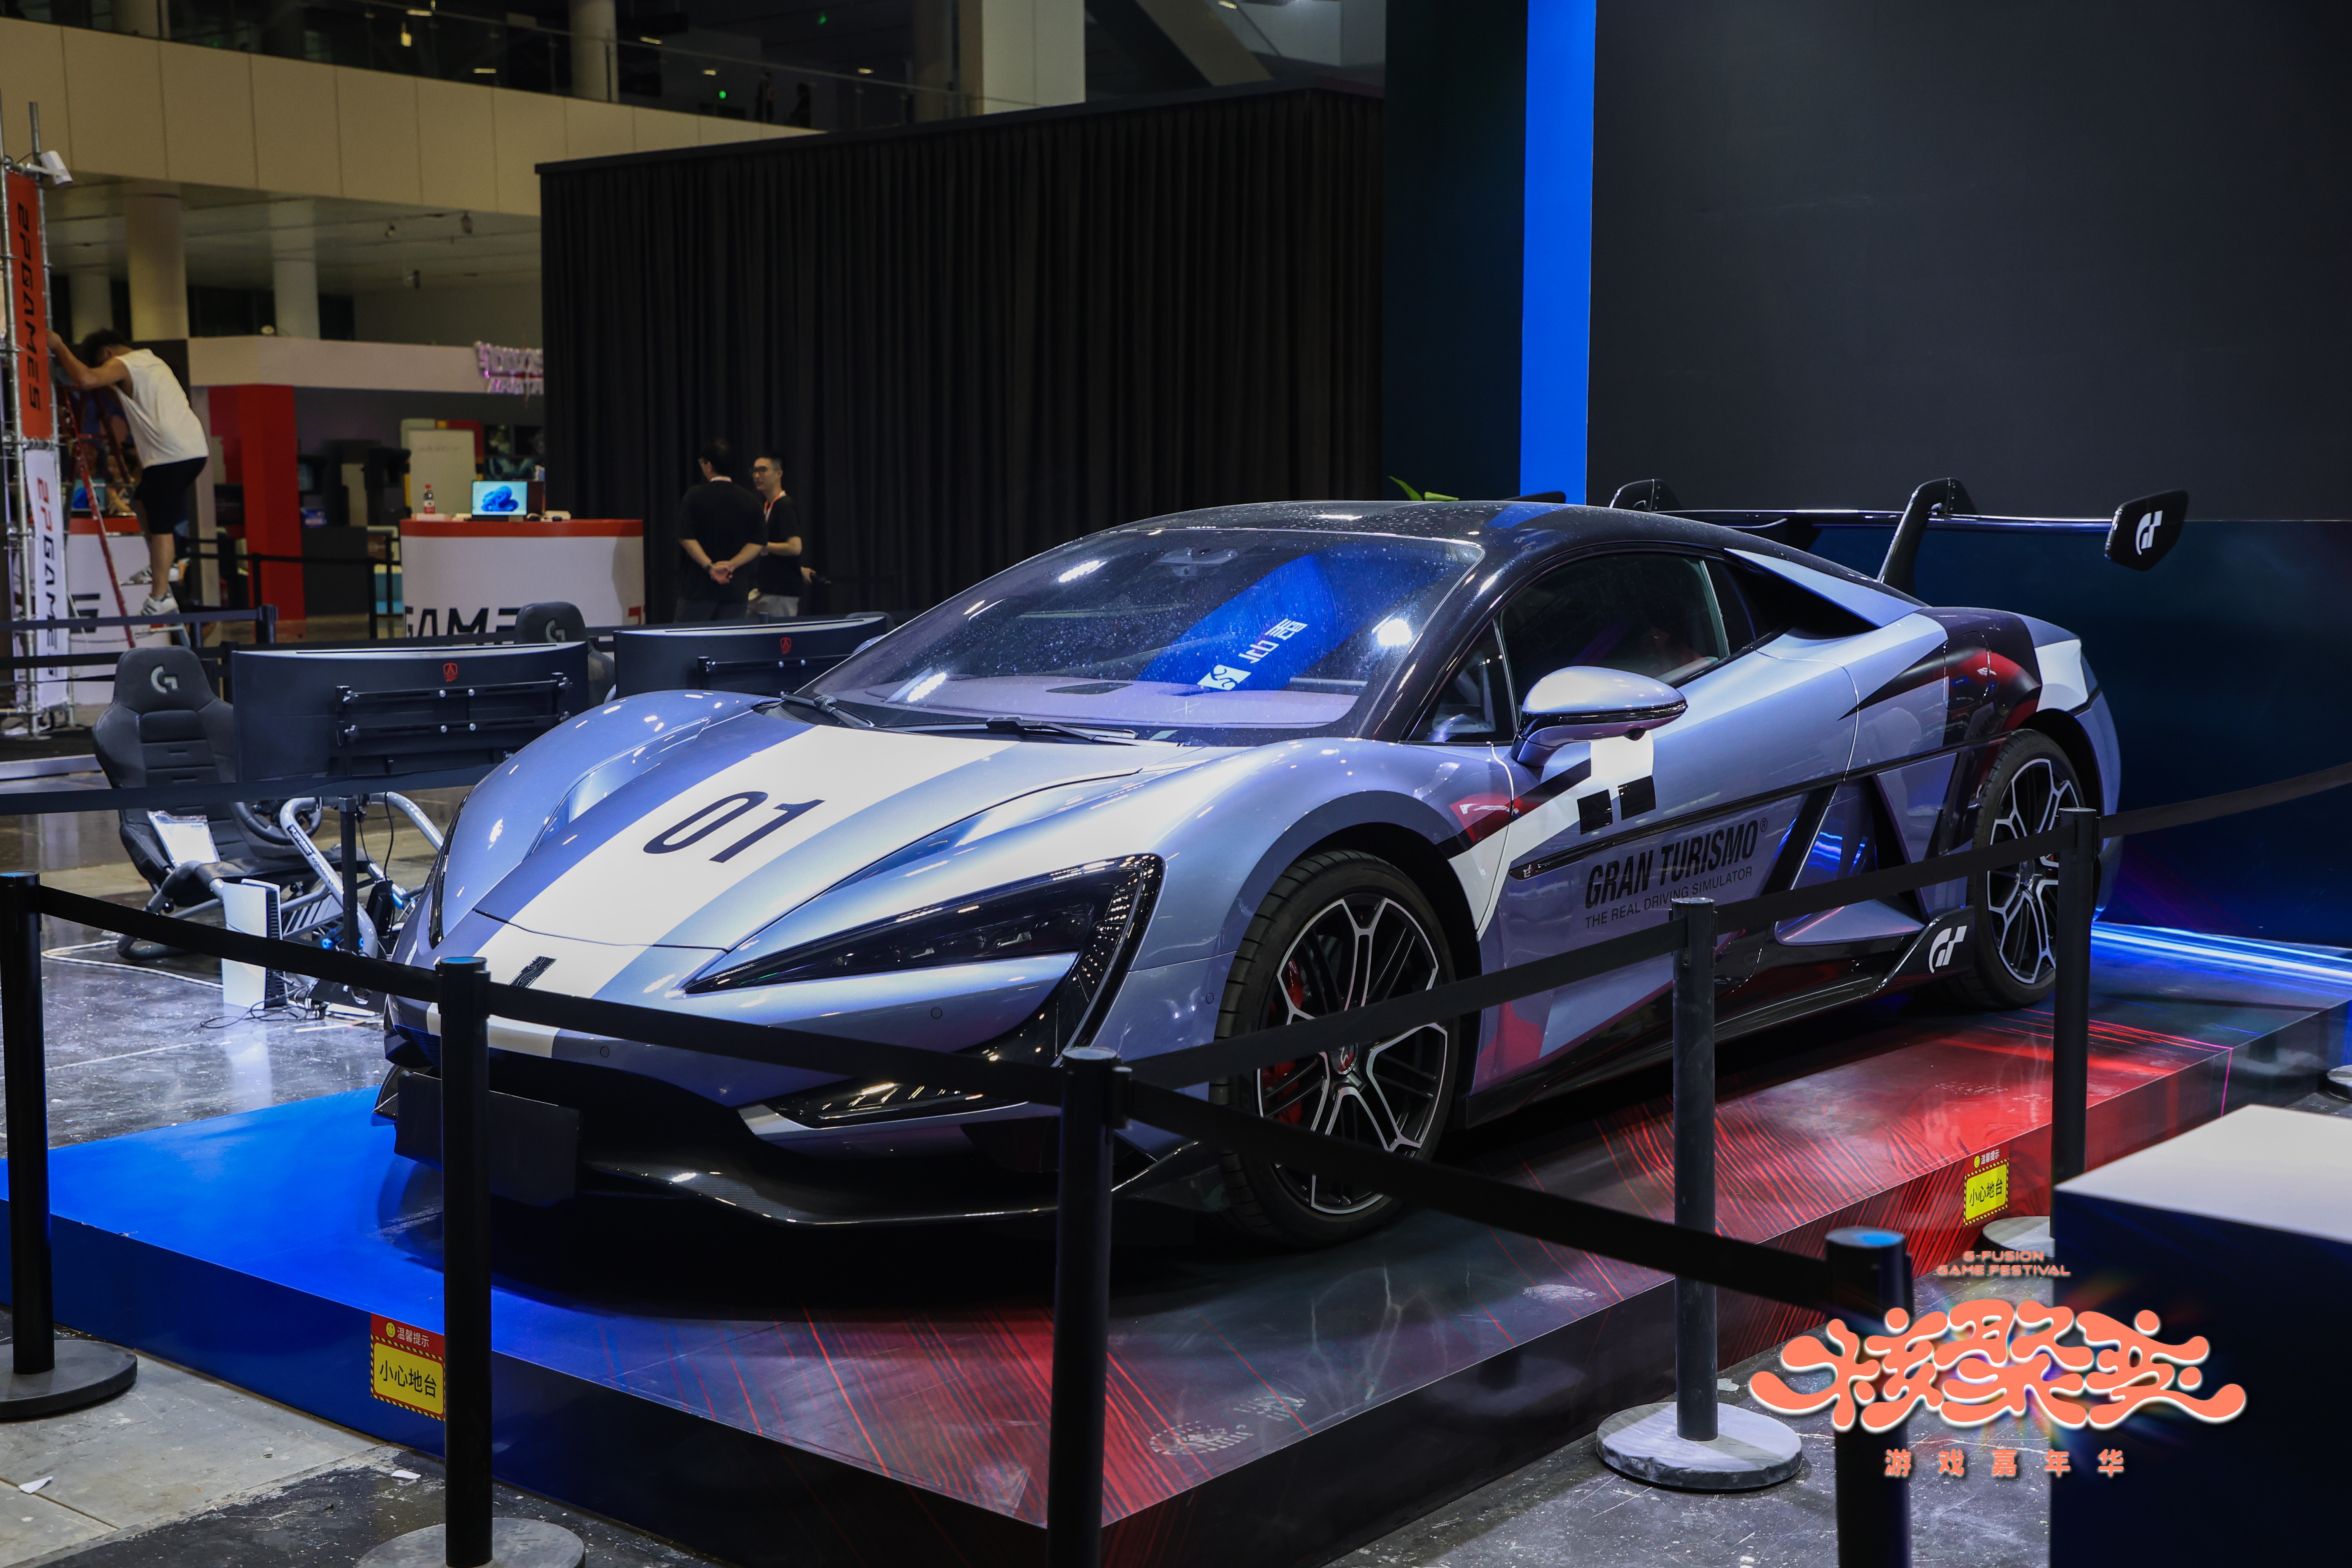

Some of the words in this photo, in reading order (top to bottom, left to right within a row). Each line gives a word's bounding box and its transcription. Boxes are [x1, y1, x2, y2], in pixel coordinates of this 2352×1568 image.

[18, 202, 41, 411] 2PGAMES
[643, 791, 826, 863] 01
[1585, 849, 1654, 909] GRAN
[1585, 911, 1608, 929] THE
[1611, 902, 1641, 921] REAL
[1644, 886, 1688, 911] DRIVING
[1692, 866, 1752, 895] SIMULATOR
[1981, 1149, 2000, 1165] 温馨提示
[1969, 1178, 2003, 1207] 小心地台
[397, 1326, 429, 1347] 温馨提示
[379, 1360, 437, 1398] 小心地台
